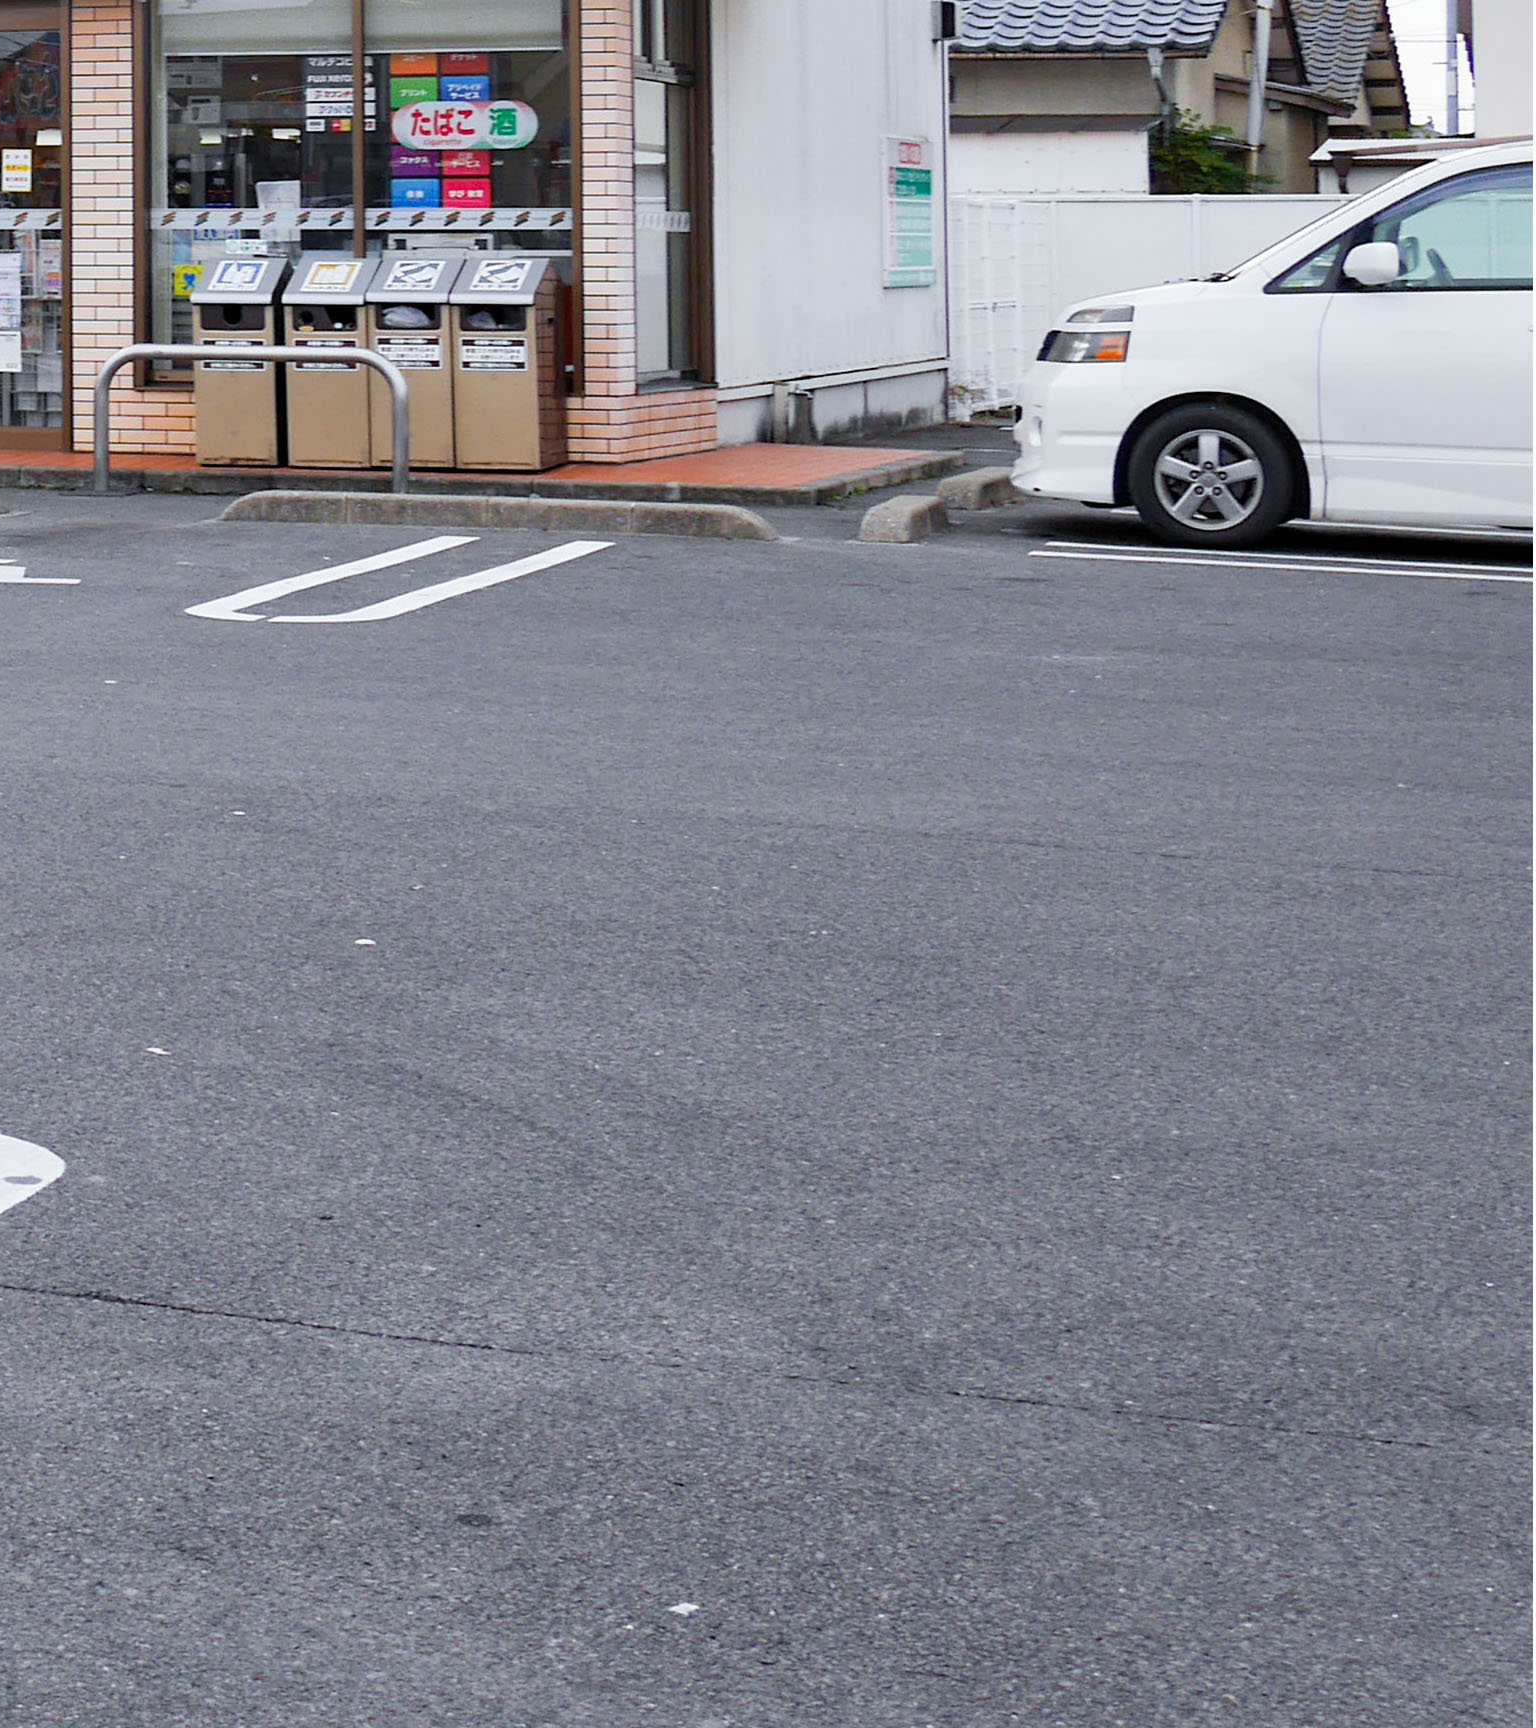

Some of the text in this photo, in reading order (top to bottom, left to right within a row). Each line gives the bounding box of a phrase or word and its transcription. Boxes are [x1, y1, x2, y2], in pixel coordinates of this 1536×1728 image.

[410, 107, 517, 137] たばこ 酒
